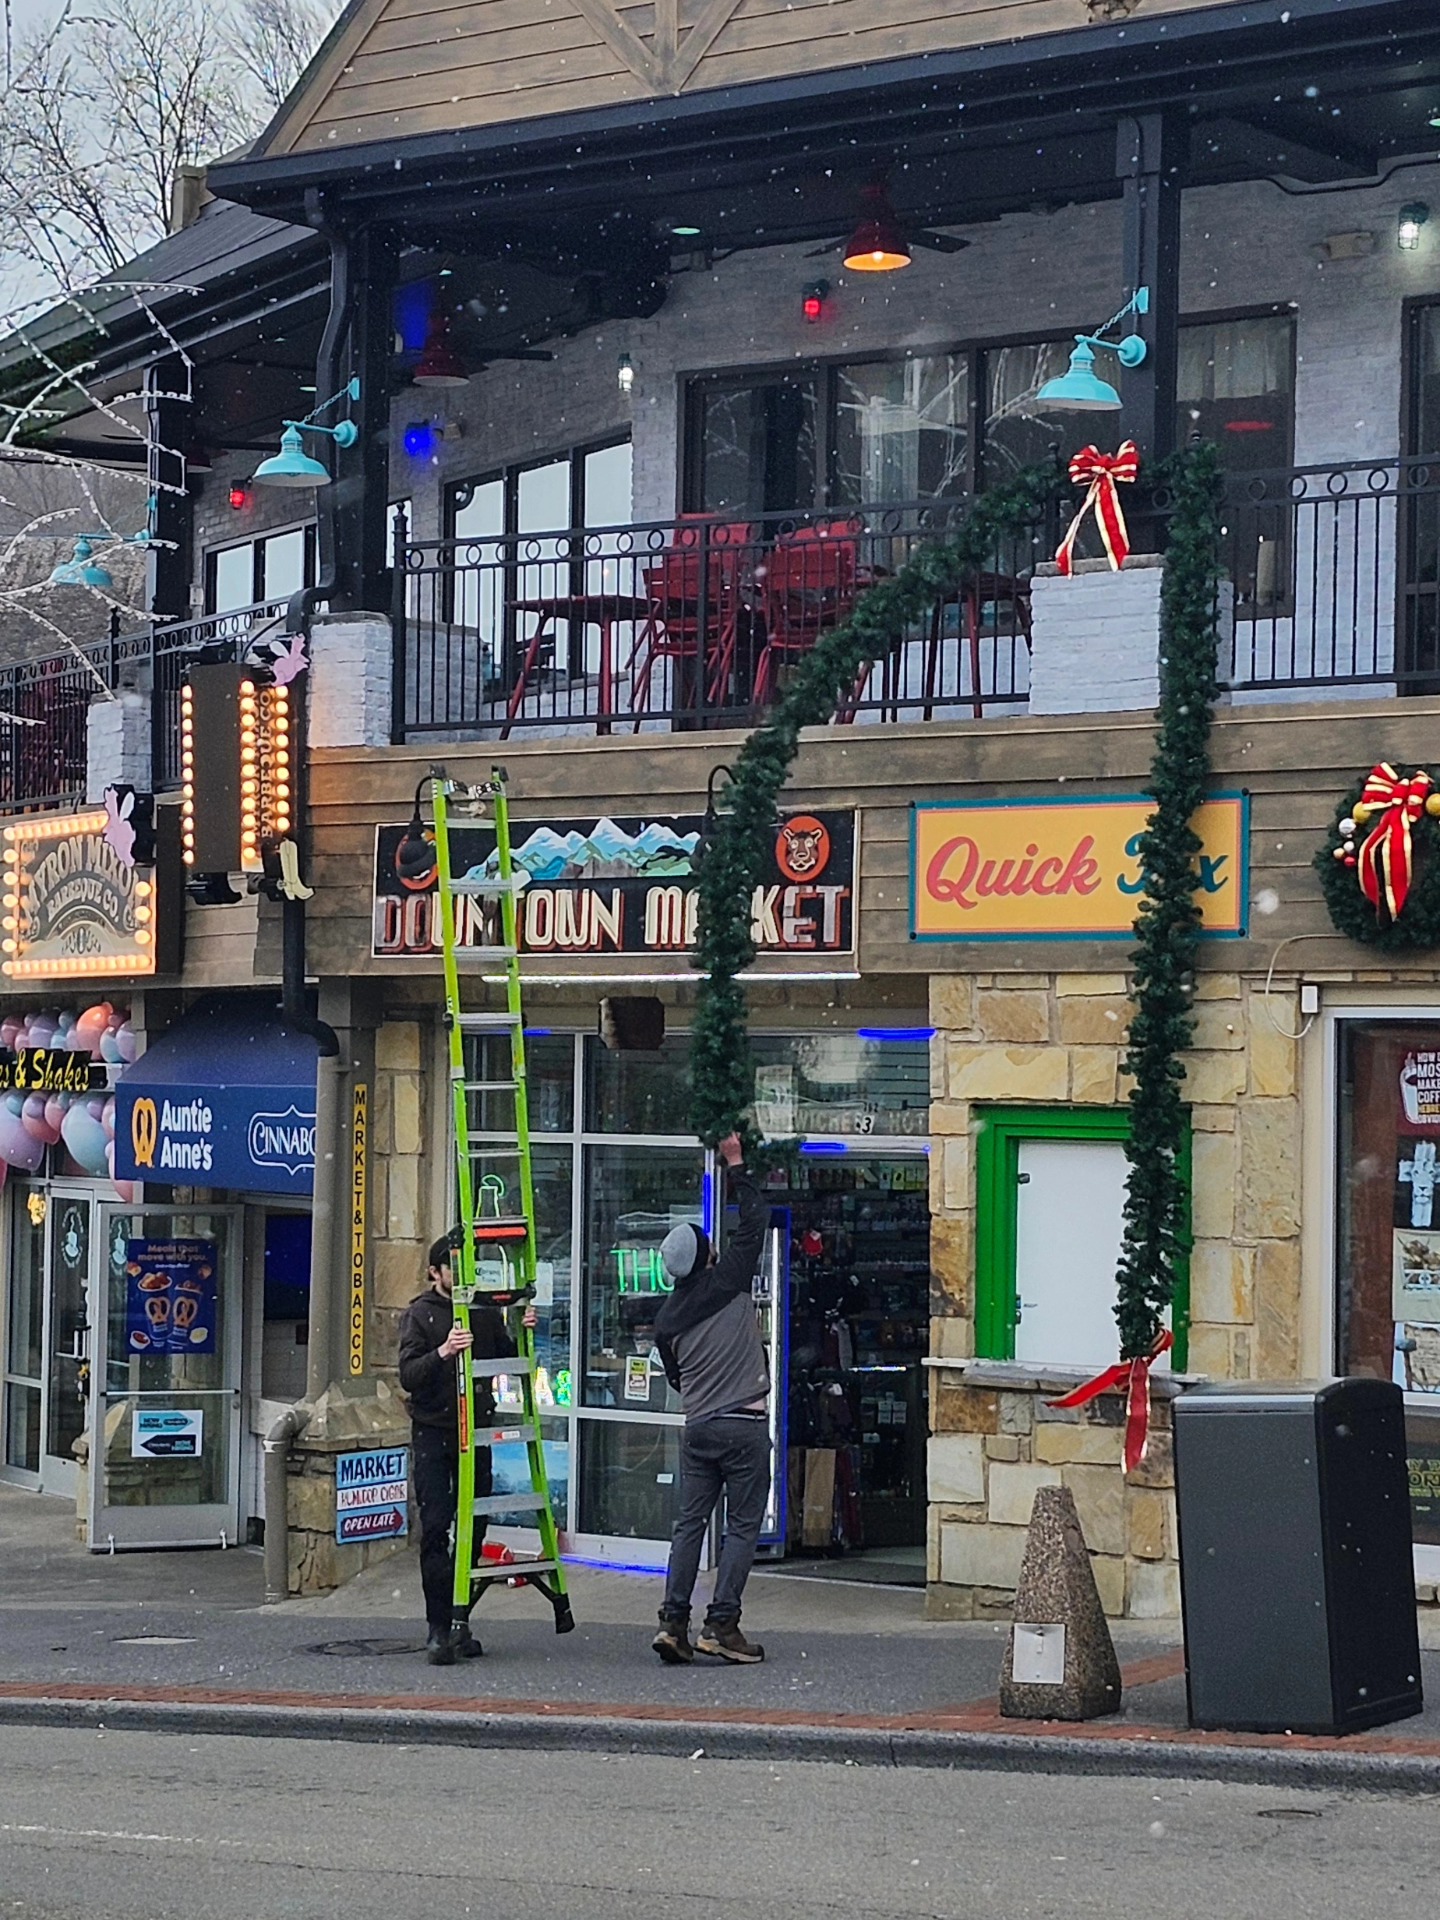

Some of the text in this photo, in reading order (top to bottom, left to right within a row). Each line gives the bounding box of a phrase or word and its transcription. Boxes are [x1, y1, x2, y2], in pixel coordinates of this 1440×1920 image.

[926, 832, 1229, 910] Quick Fx
[47, 878, 103, 923] BARBEQUE
[644, 885, 847, 947] MKET
[15, 1048, 26, 1089] &
[31, 1049, 89, 1091] Shakes
[160, 1097, 213, 1133] Auntie
[160, 1136, 213, 1171] Anne's
[351, 1232, 363, 1369] TOBACCO
[341, 1453, 405, 1481] MARKET
[344, 1513, 396, 1531] OPEN LATE
